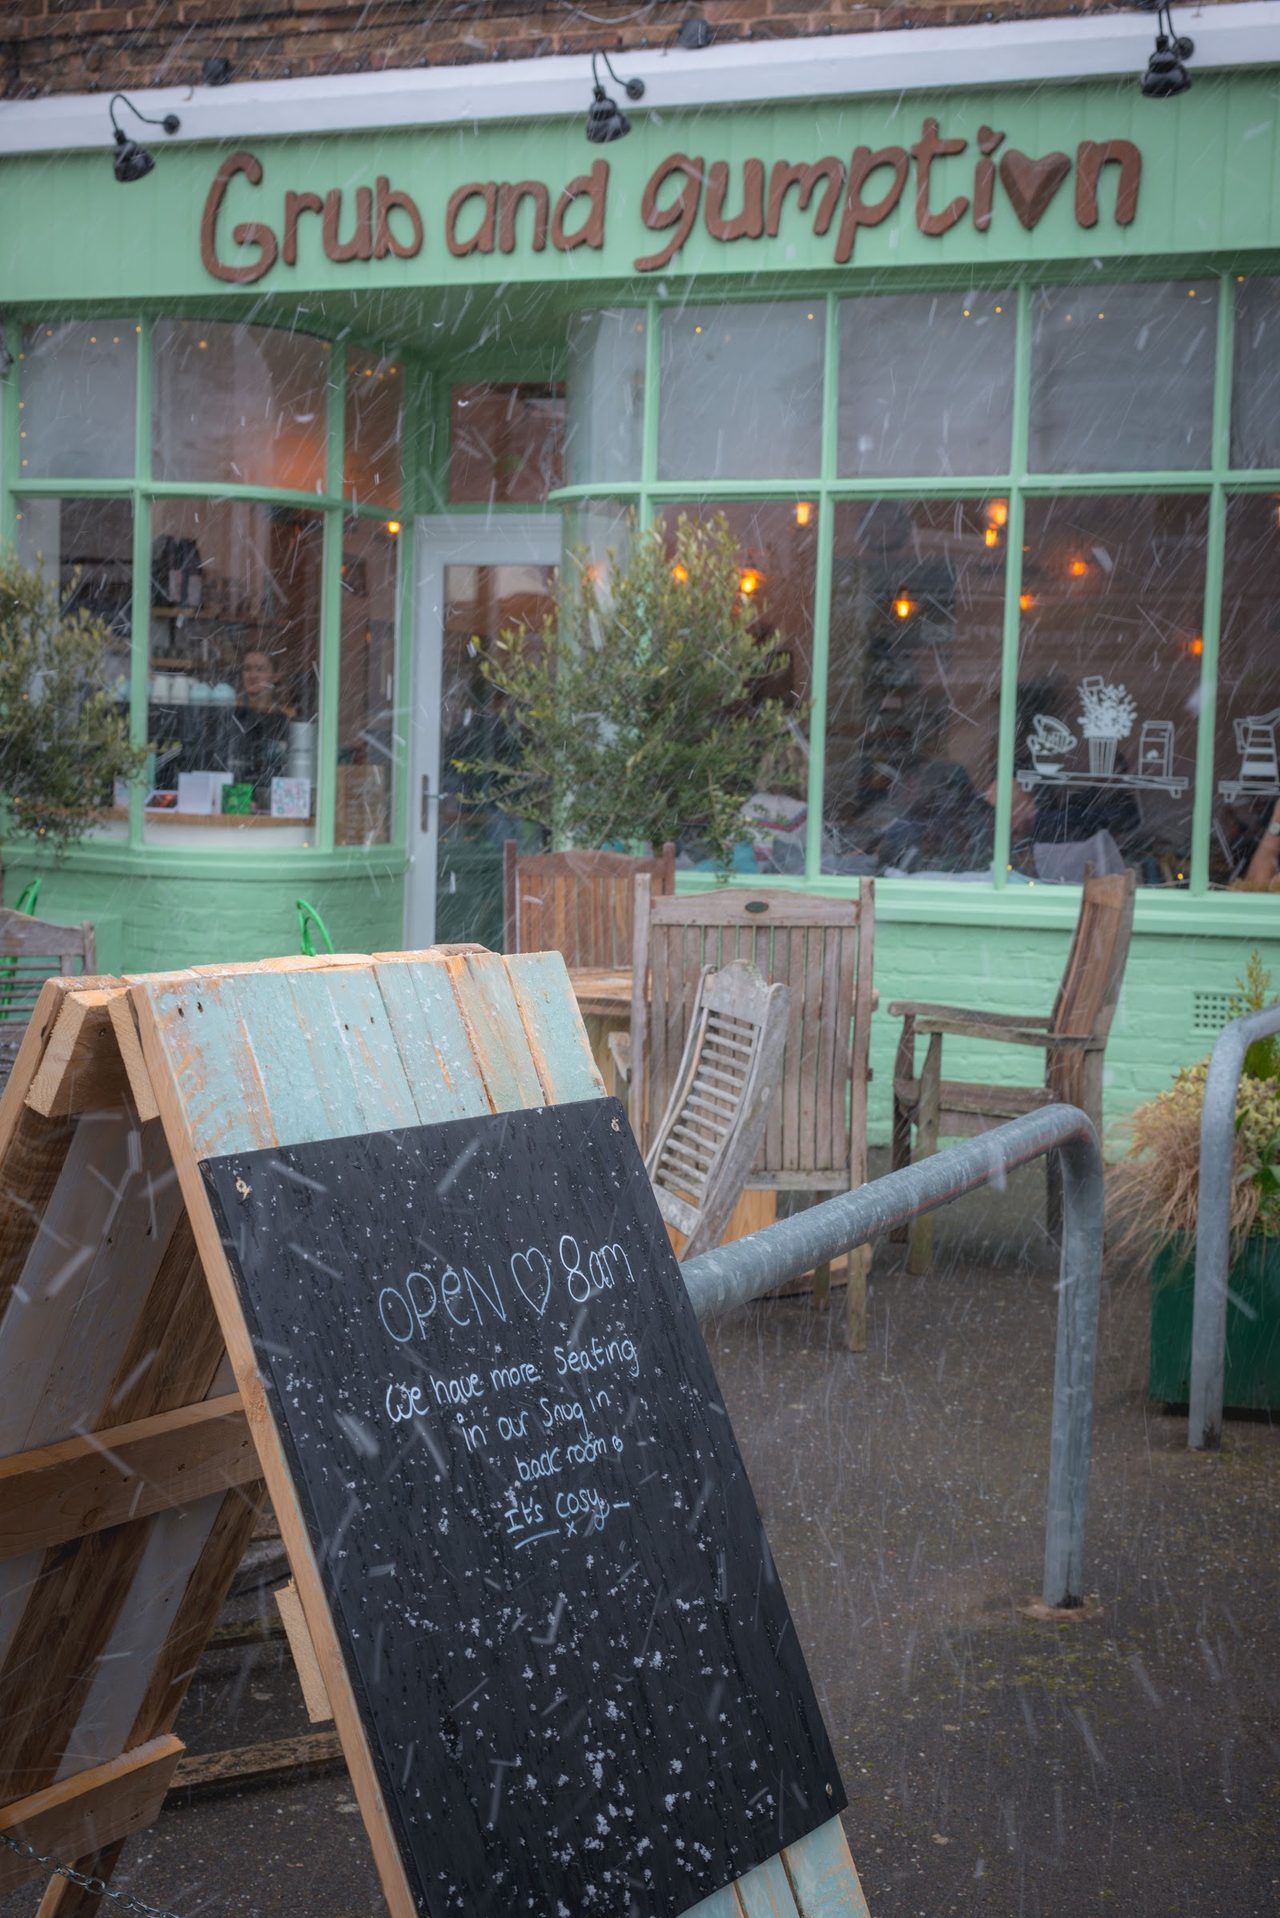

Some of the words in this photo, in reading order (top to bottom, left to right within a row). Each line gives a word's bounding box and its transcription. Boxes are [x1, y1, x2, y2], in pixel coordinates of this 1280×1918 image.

[200, 151, 424, 284] Grub
[445, 158, 610, 257] and
[633, 116, 1143, 272] gumptin
[559, 1235, 635, 1303] 8am
[386, 1384, 430, 1423] We
[430, 1373, 484, 1405] have
[490, 1362, 541, 1390] more
[457, 1413, 487, 1452] in
[498, 1410, 528, 1441] our
[590, 1390, 612, 1413] in
[514, 1446, 563, 1481] back
[566, 1437, 607, 1464] room
